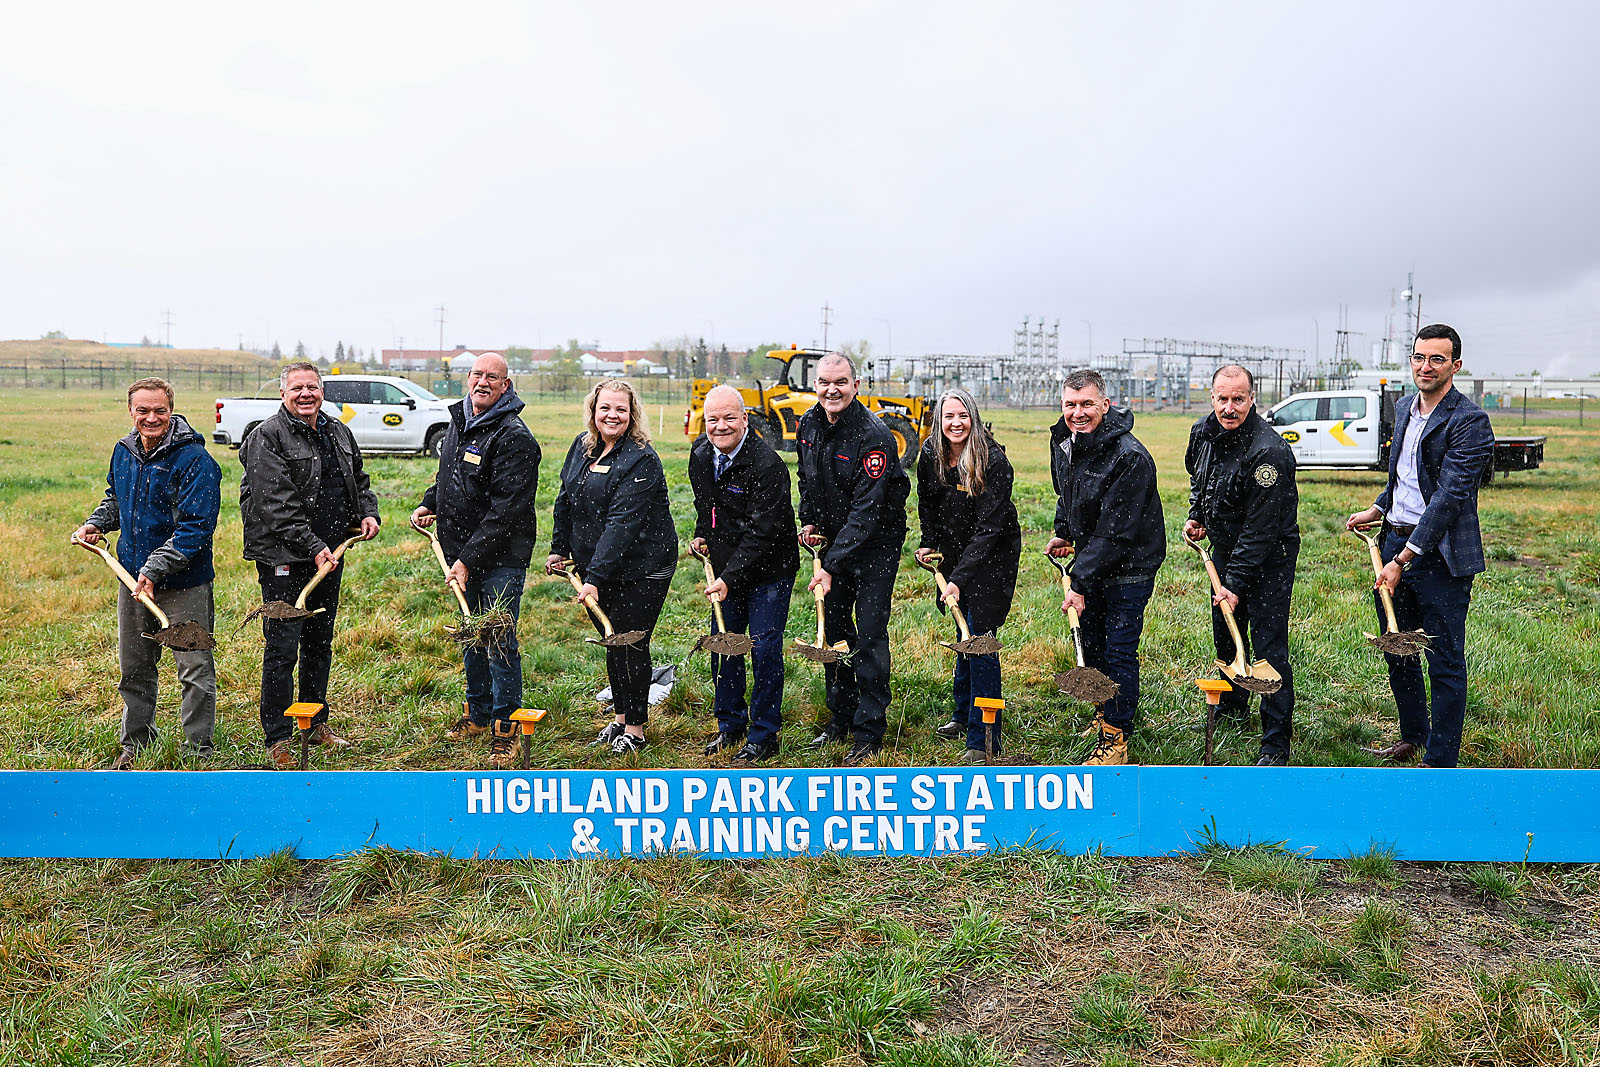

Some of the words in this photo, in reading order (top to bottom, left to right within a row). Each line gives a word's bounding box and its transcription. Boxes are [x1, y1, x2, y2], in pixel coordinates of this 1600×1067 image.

[384, 415, 401, 424] PCL
[1282, 432, 1298, 441] PCL
[466, 778, 670, 814] HIGHLAND
[683, 776, 795, 814] PARK
[808, 774, 898, 813] FIRE
[911, 773, 1094, 812] STATION
[571, 817, 602, 854] &
[614, 815, 810, 854] TRAINING
[823, 814, 987, 853] CENTRE
